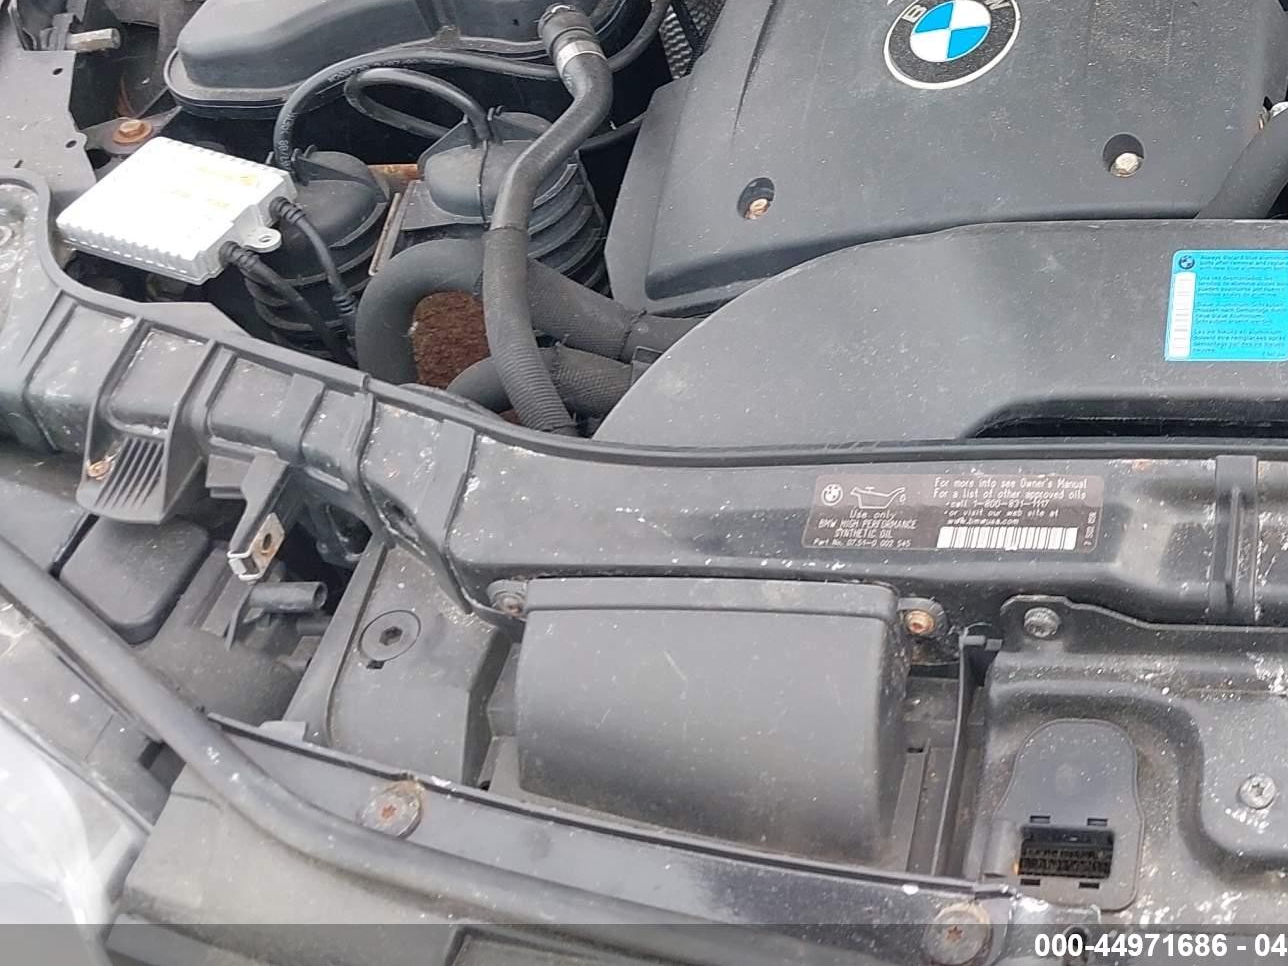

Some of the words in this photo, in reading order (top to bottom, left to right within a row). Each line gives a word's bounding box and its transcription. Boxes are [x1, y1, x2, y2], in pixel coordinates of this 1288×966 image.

[934, 477, 950, 489] For
[953, 480, 976, 489] more
[978, 477, 998, 489] info
[1001, 480, 1016, 489] see
[1019, 476, 1053, 489] Owner's
[1056, 478, 1088, 489] Manual
[933, 488, 949, 499] For
[952, 490, 959, 499] a
[963, 488, 979, 499] list
[983, 488, 994, 499] of
[998, 488, 1021, 499] other
[1024, 488, 1065, 501] approved
[1068, 488, 1087, 500] oils
[849, 509, 867, 519] Use
[873, 509, 897, 521] only
[818, 519, 838, 529] BMW
[840, 519, 859, 529] HIGH
[861, 519, 918, 530] PERFORMANCE
[833, 528, 878, 538] SYNTHETIC
[879, 529, 895, 539] OIL
[813, 537, 831, 547] Part
